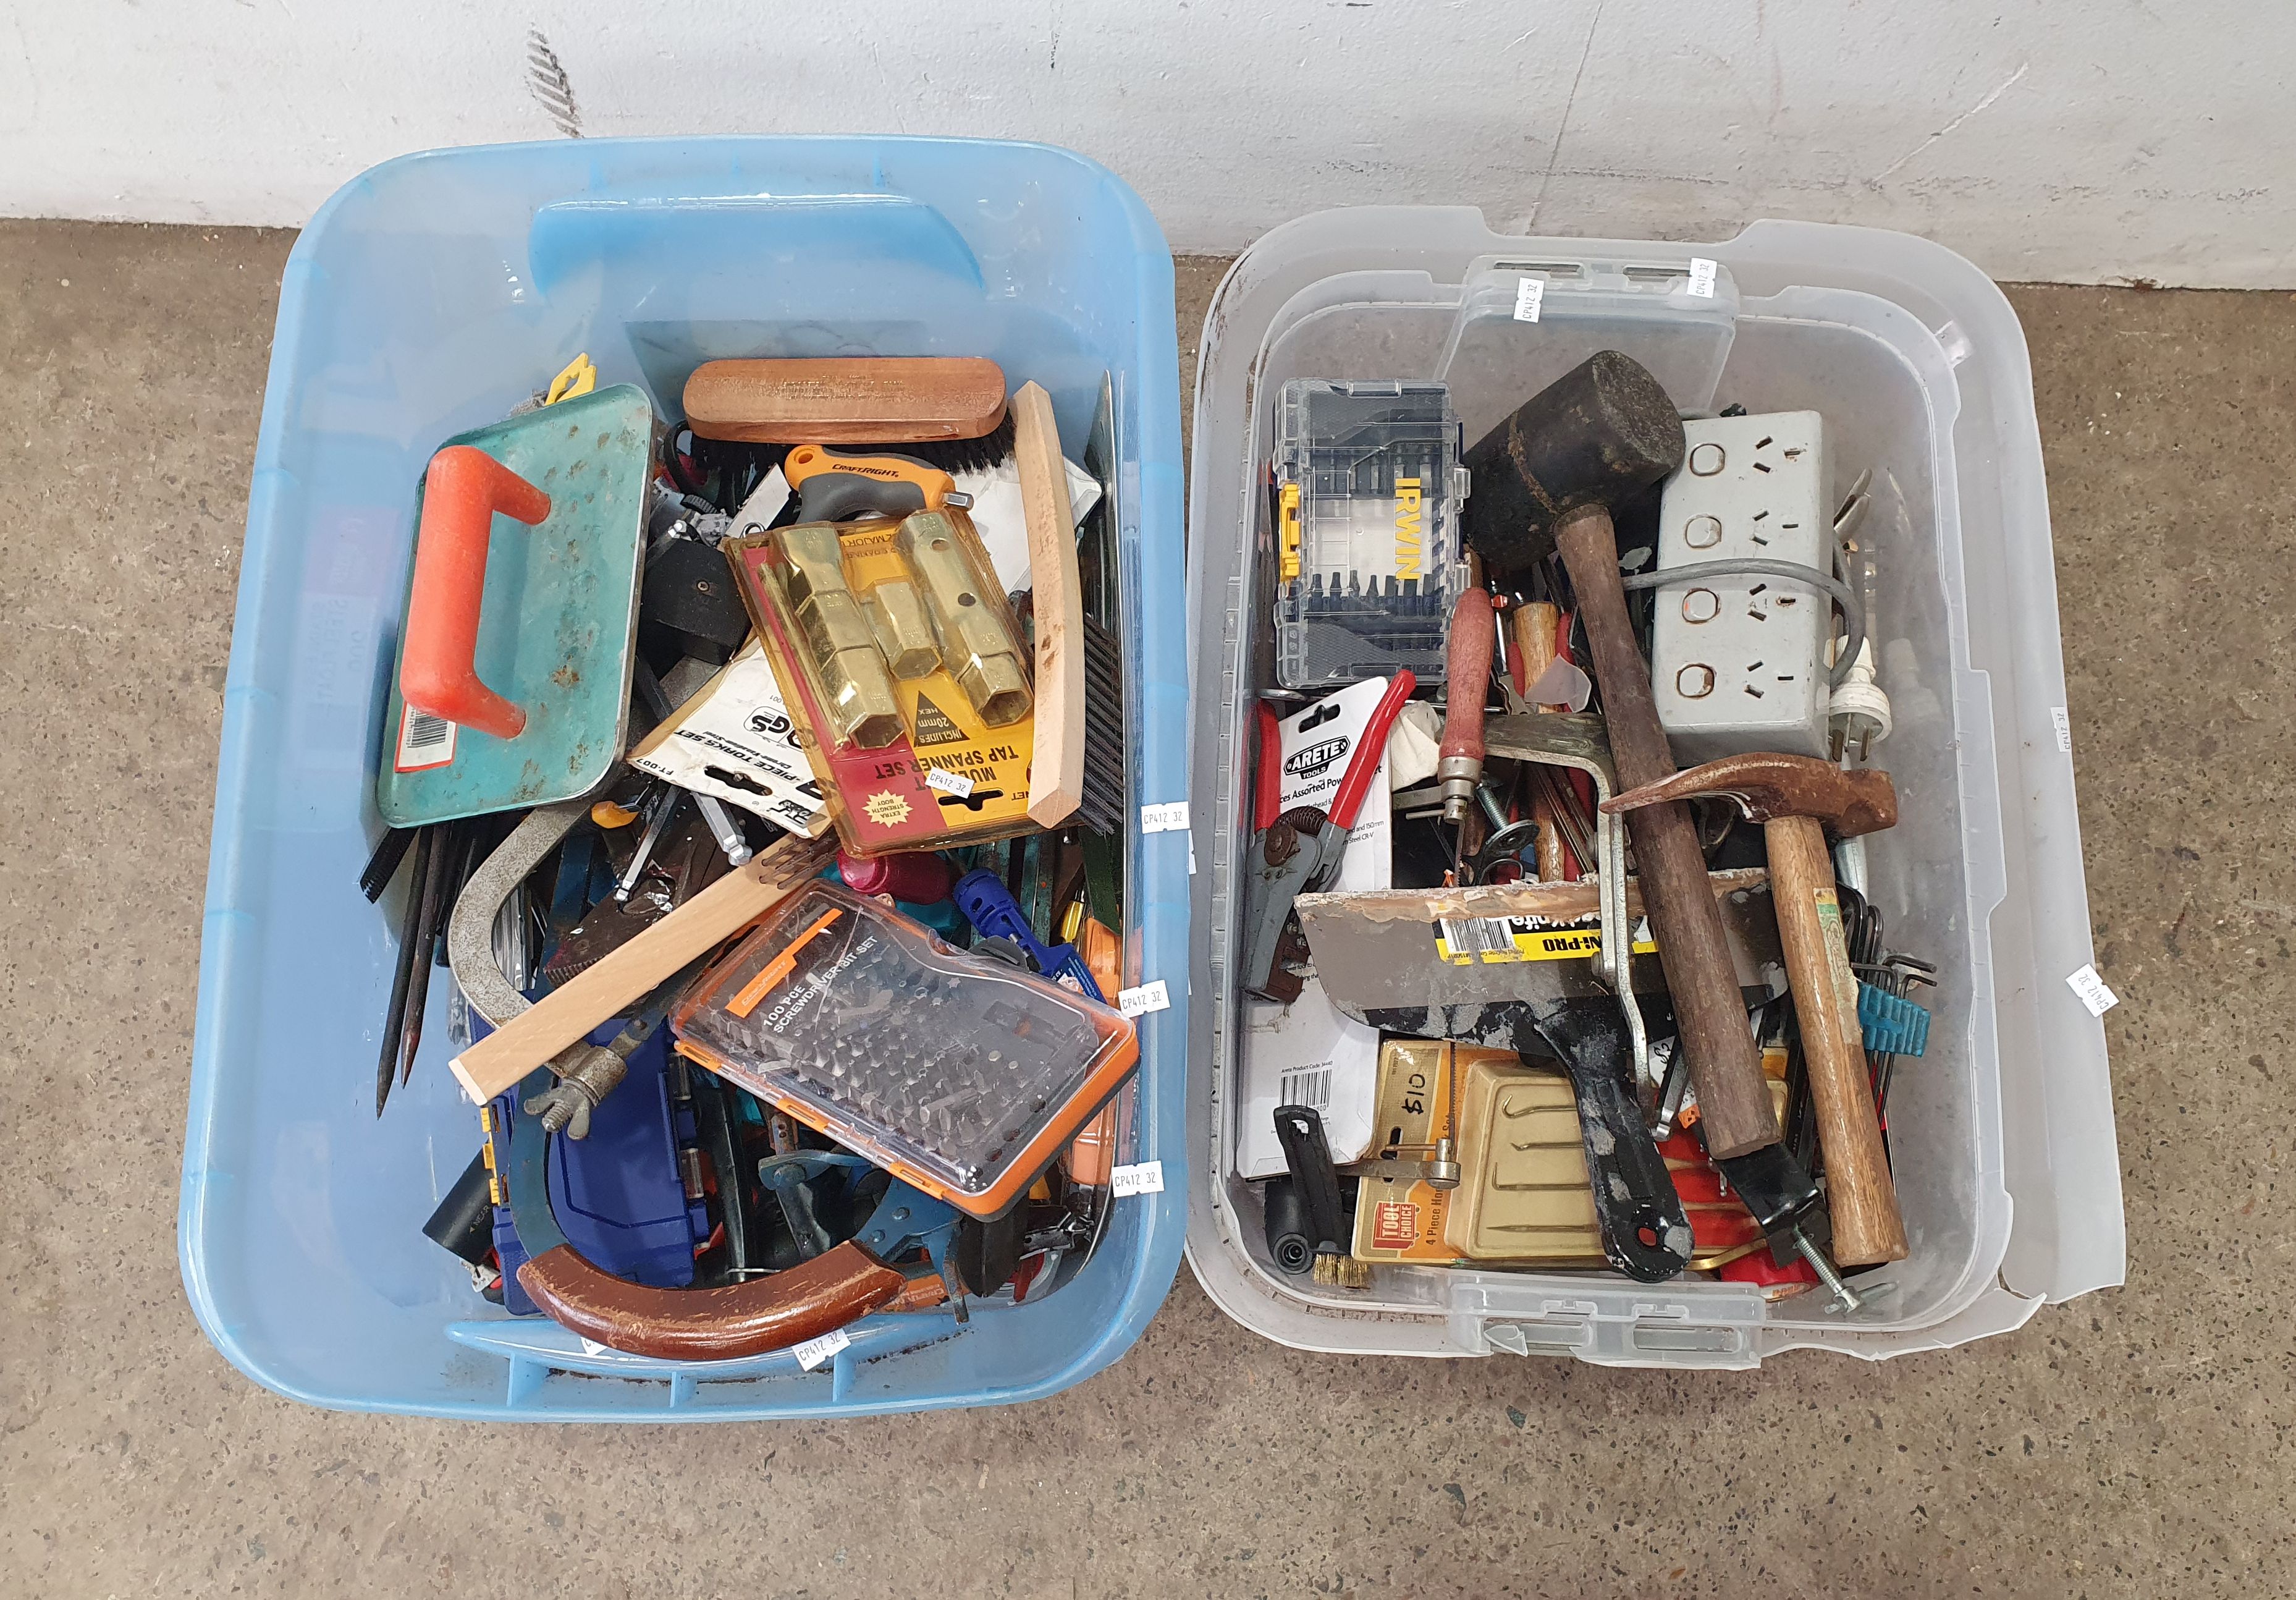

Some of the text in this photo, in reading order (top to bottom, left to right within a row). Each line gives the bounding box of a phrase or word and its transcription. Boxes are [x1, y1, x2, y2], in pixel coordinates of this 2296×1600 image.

[1522, 284, 1538, 319] CP412 32
[832, 463, 900, 478] CRAFTRIGHT
[1395, 477, 1422, 580] IRWIN
[846, 535, 885, 547] MAJOR
[918, 717, 950, 729] 20mm
[673, 729, 707, 743] SET
[918, 729, 963, 743] INCLUDES
[703, 739, 755, 763] TORKS
[1291, 740, 1341, 771] ARETE
[875, 745, 1019, 779] TAP SPANNER SET
[929, 772, 953, 787] CP412
[956, 782, 967, 792] 32
[1302, 766, 1327, 779] TOOLS
[1291, 779, 1325, 800] Assorted
[1327, 777, 1343, 789] Pow
[871, 803, 905, 813] STRENGTH
[877, 798, 895, 806] BODY
[880, 810, 901, 819] EXTRA
[1144, 811, 1183, 824] CP412 32
[1361, 831, 1374, 840] CR-V
[774, 935, 879, 1034] SCREWDRIVER BIT SET
[2078, 973, 2109, 1010] CP412 32
[763, 984, 806, 1027] 100 PCE
[1122, 991, 1162, 1010] CP412 32
[1401, 1073, 1426, 1115] $10
[1115, 1172, 1157, 1187] CP412 32
[1382, 1203, 1400, 1237] TOOL
[1399, 1204, 1414, 1239] CHOICE
[1427, 1207, 1440, 1237] Piece
[1425, 1238, 1436, 1247] 4
[798, 1332, 841, 1361] CP412 32
